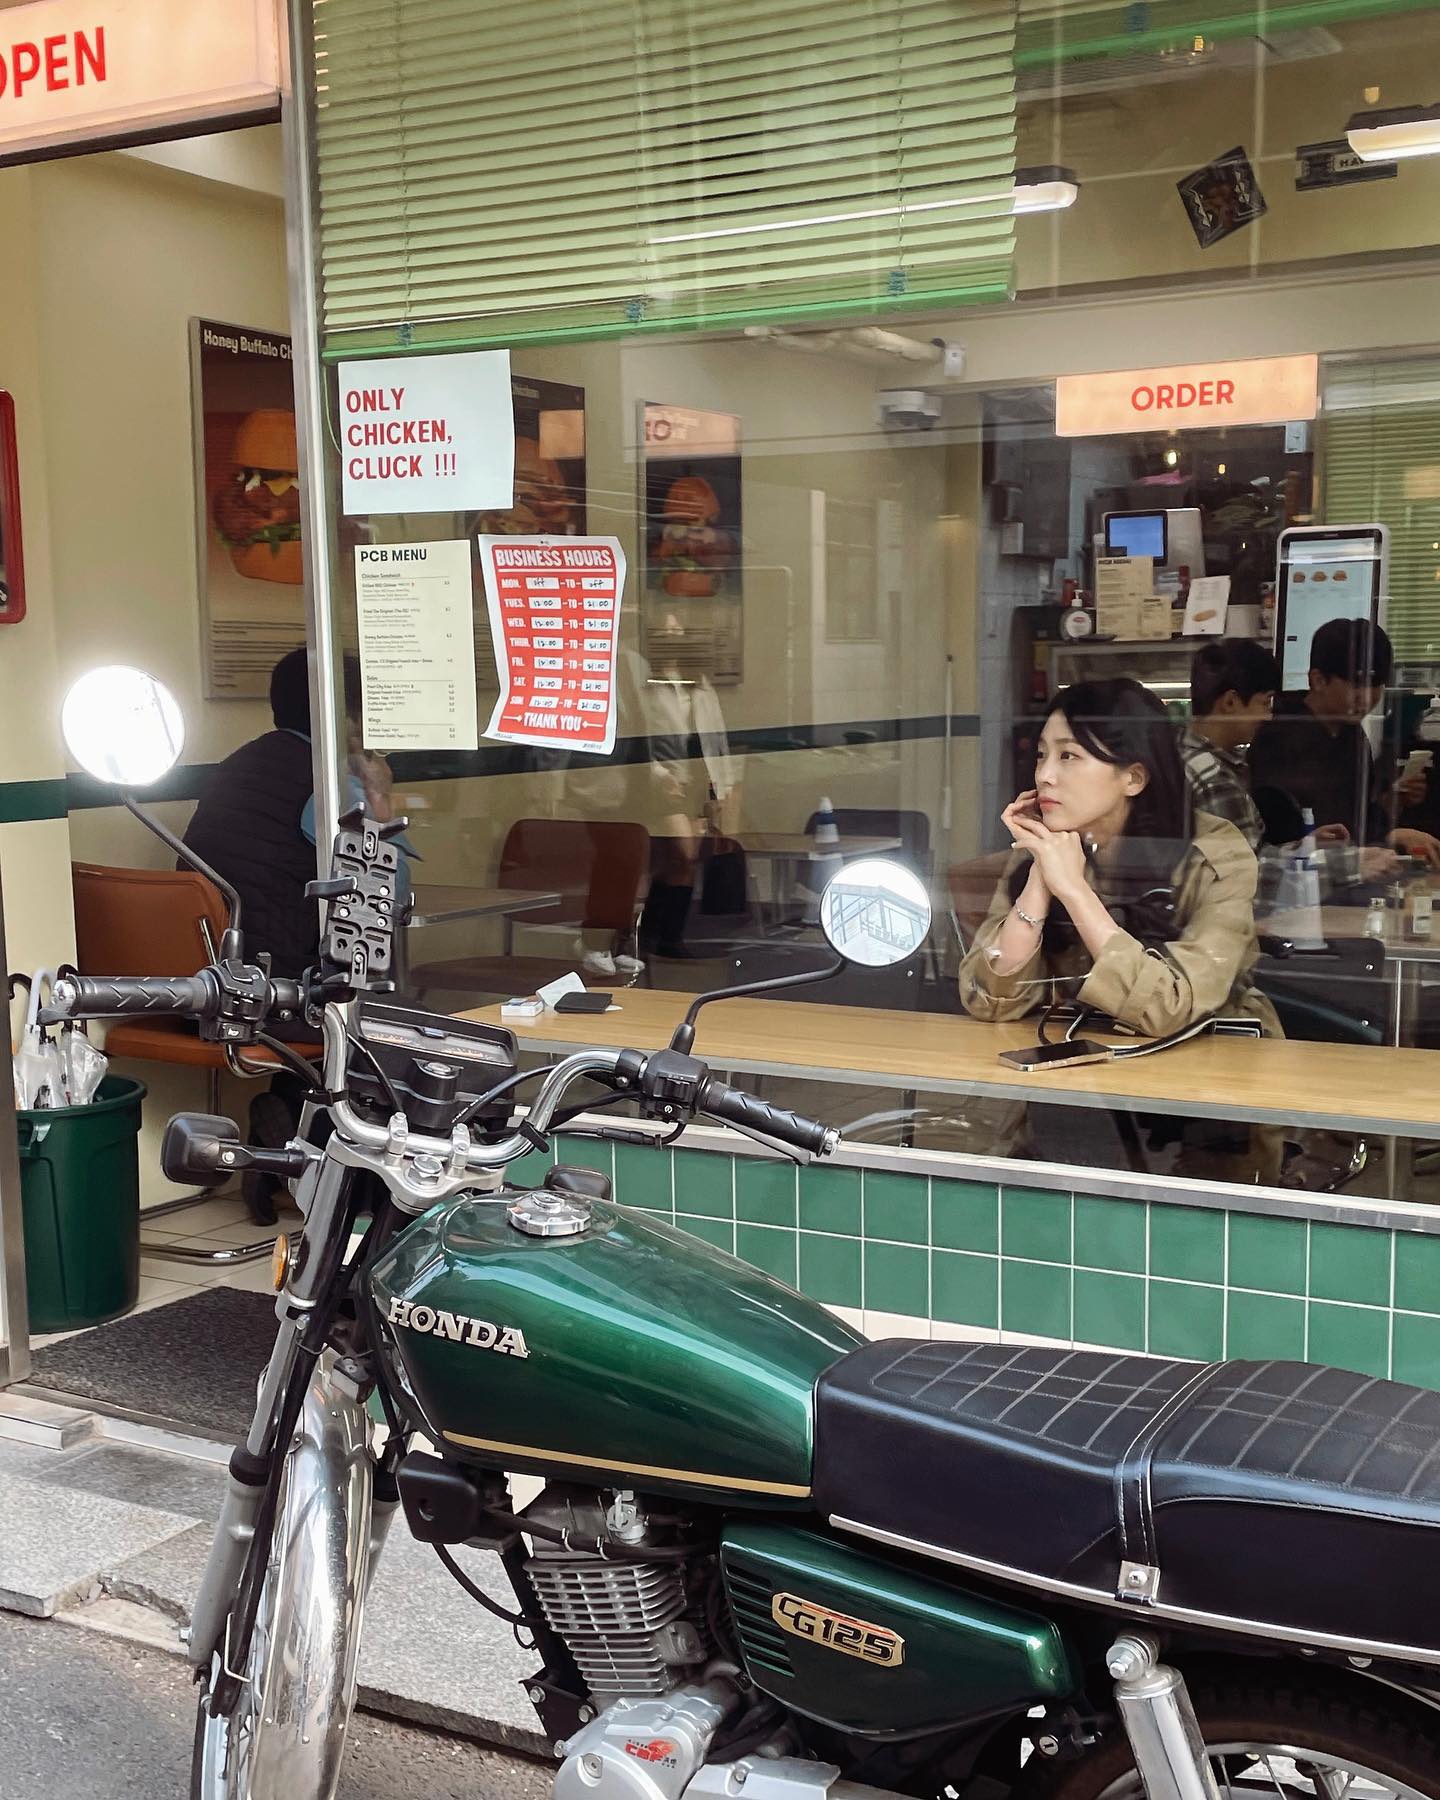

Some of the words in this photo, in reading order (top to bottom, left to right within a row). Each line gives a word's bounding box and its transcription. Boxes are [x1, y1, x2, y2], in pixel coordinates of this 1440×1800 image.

[204, 329, 238, 353] Honey
[241, 337, 278, 357] Buffalo
[346, 388, 405, 413] ONLY
[1131, 380, 1235, 411] ORDER
[348, 419, 453, 447] CHICKEN,
[349, 455, 423, 480] CLUCK
[435, 453, 456, 476] !!!
[360, 550, 388, 562] PCB
[392, 549, 427, 561] MENU
[495, 549, 562, 566] BUSINESS
[562, 550, 612, 566] HOURS
[502, 579, 521, 588] MON.
[504, 598, 525, 608] TUES.
[507, 618, 526, 627] WED.
[523, 712, 559, 729] THANK
[560, 715, 583, 732] YOU
[388, 1297, 531, 1359] HONDA
[779, 1597, 896, 1661] CG125
